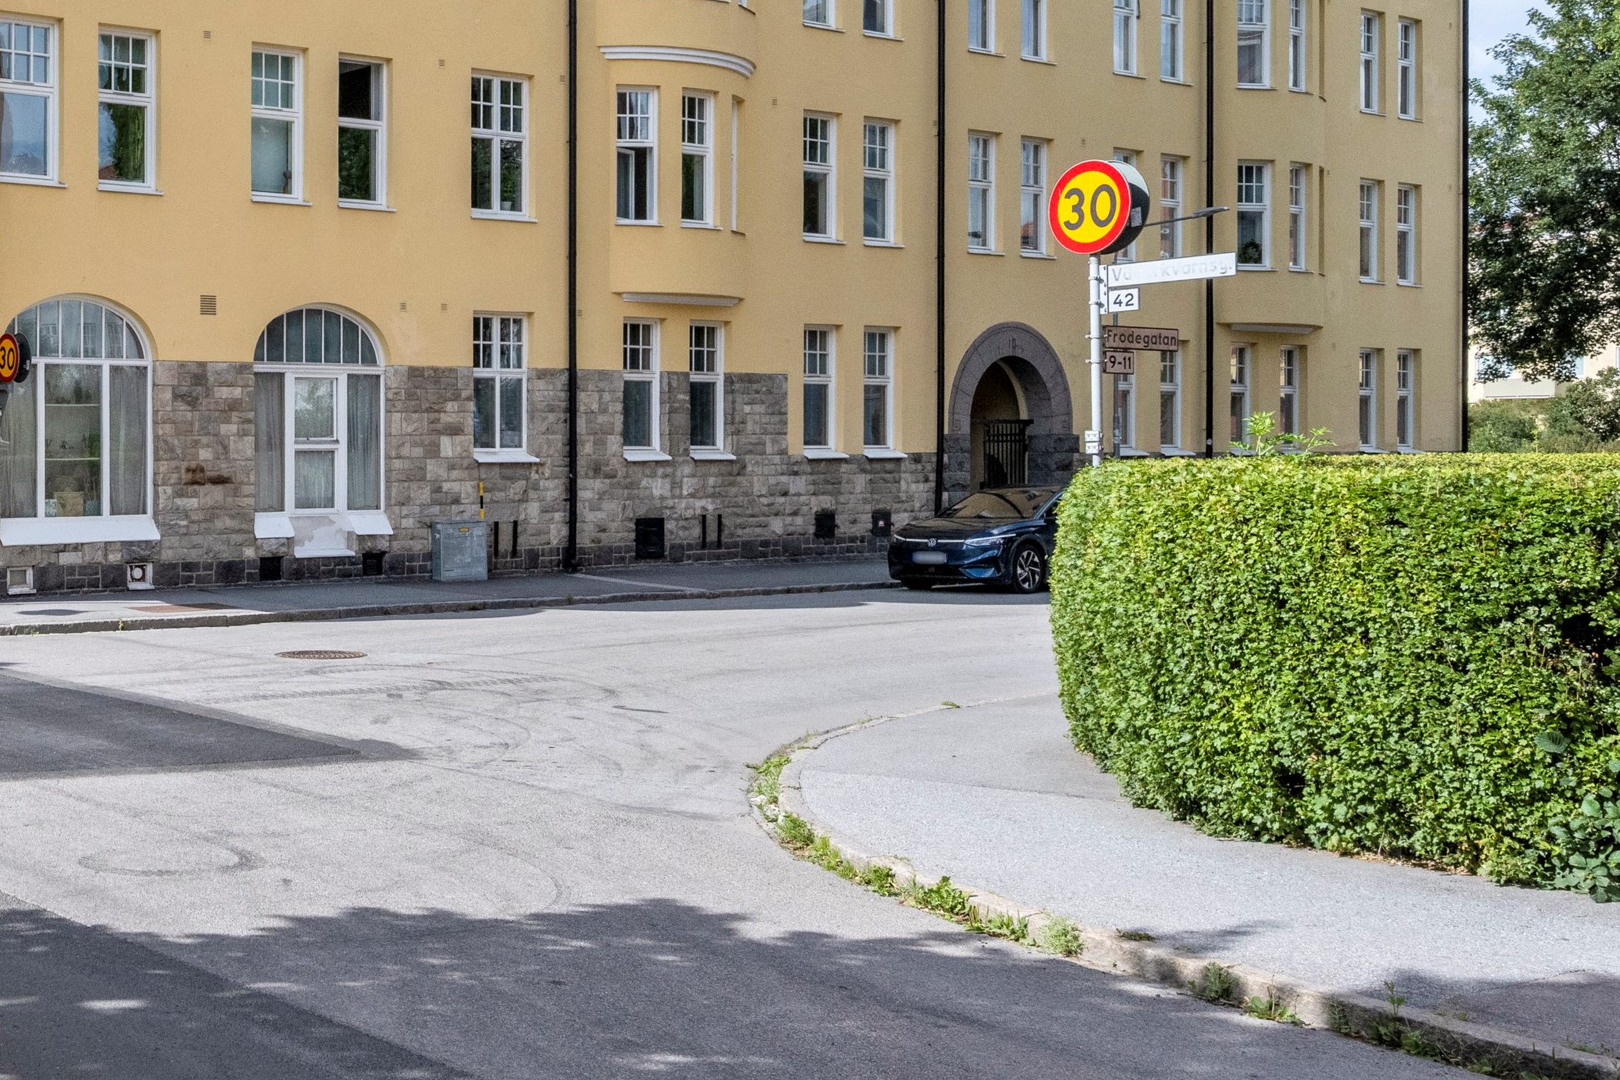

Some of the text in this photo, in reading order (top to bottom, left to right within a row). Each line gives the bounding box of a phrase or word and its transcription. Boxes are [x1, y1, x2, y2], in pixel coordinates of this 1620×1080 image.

[1063, 184, 1117, 231] 30
[1112, 260, 1232, 282] Vkvarnsg.
[1113, 293, 1134, 307] 42
[1106, 329, 1177, 348] Frodegatan
[0, 346, 15, 371] 30
[1109, 355, 1132, 370] 9-11
